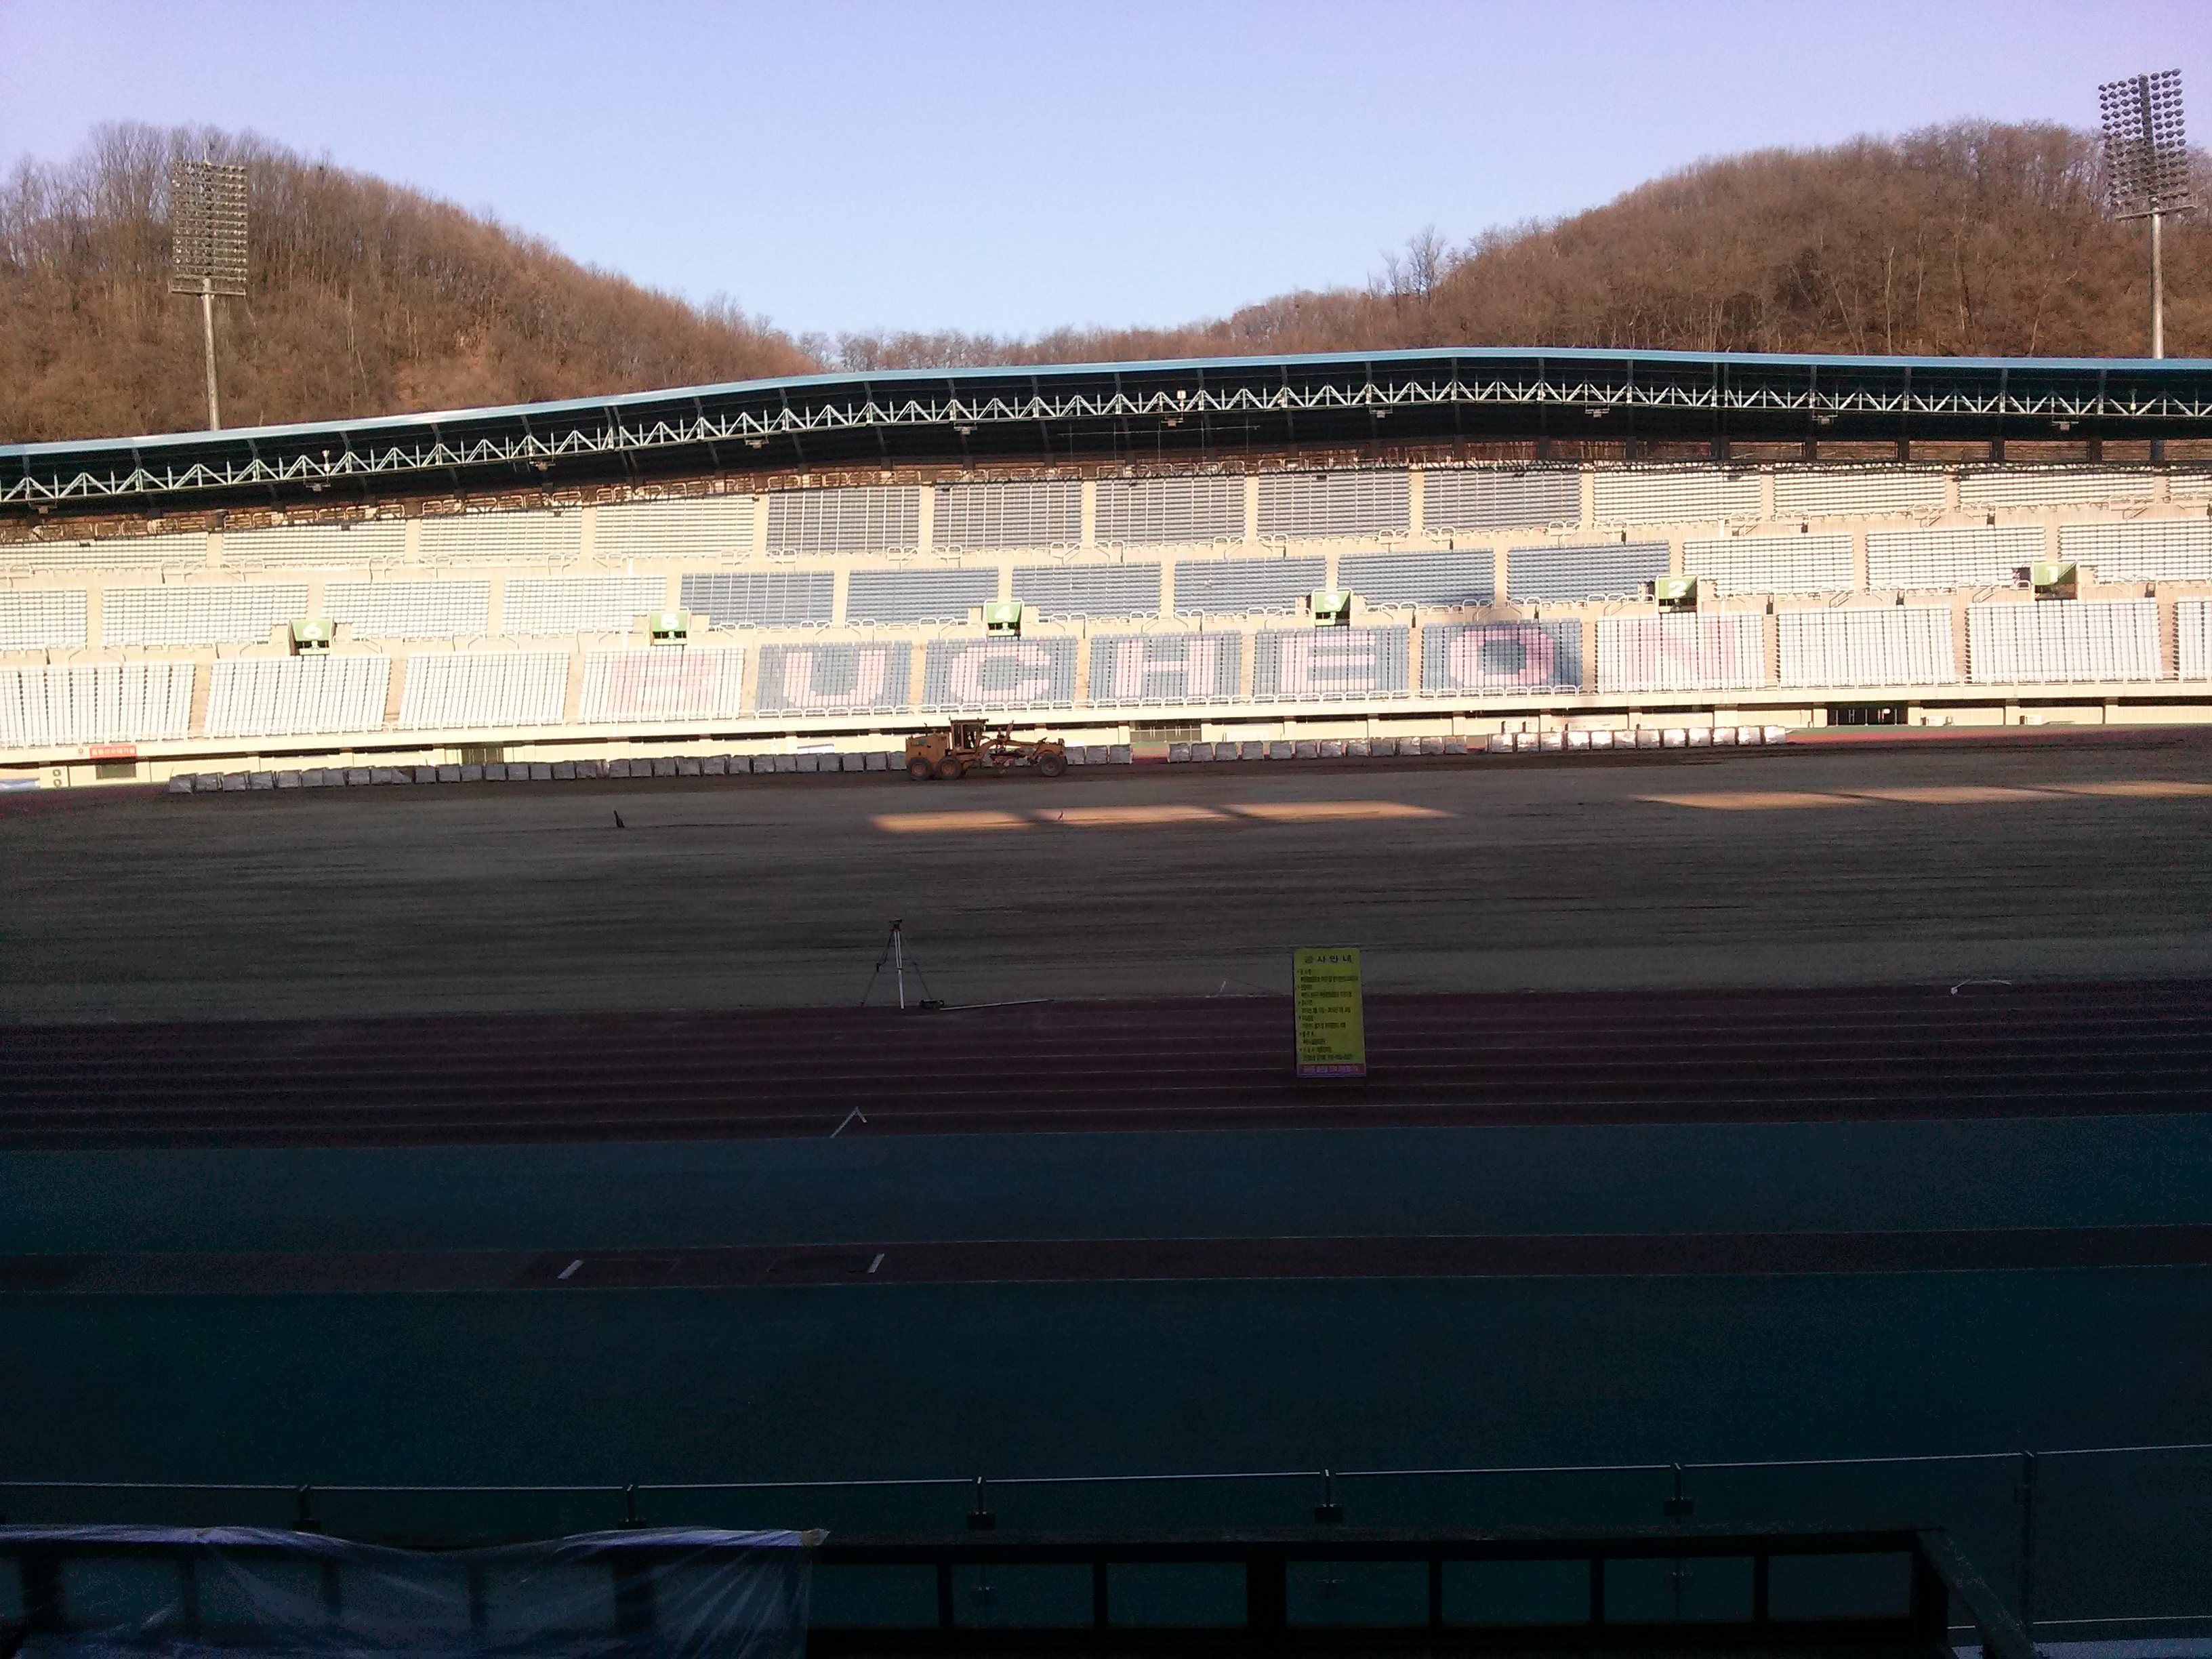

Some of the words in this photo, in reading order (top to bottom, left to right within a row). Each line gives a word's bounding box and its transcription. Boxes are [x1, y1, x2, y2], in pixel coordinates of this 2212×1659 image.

[1668, 580, 1686, 597] 2
[1324, 594, 1341, 611] 3
[995, 605, 1012, 621] 4
[303, 622, 323, 639] 6
